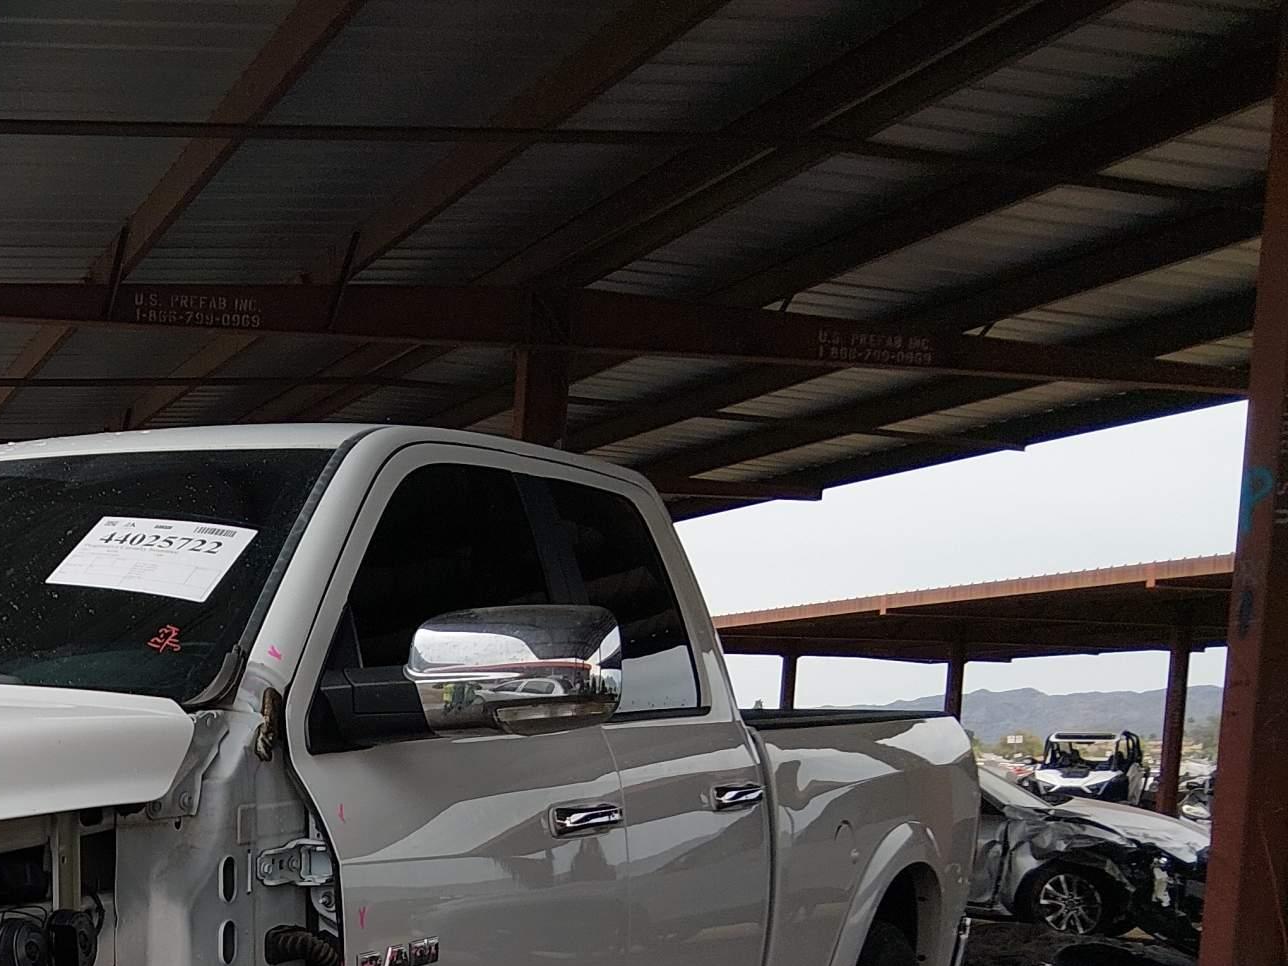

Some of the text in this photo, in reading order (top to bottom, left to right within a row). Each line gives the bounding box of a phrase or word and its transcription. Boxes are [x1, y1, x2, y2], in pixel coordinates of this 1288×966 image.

[134, 292, 262, 313] U.S. PREFAB INC.
[99, 531, 223, 554] 44025722
